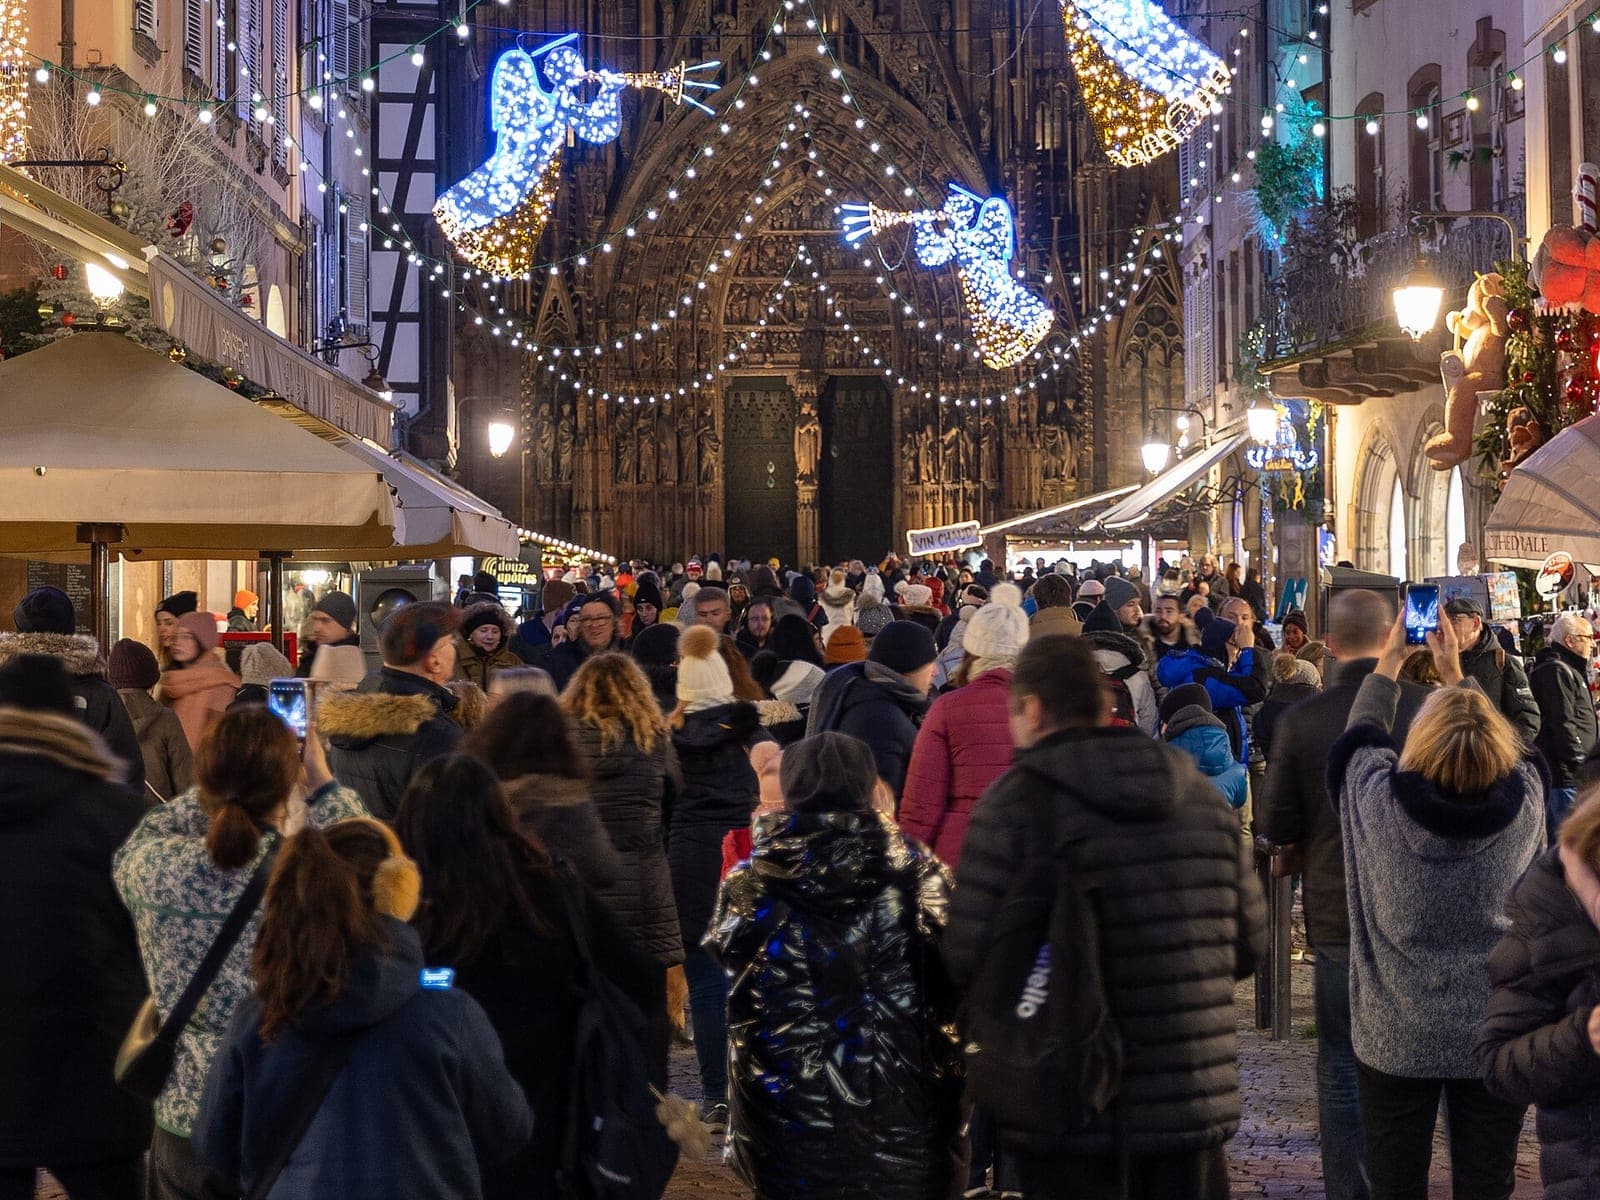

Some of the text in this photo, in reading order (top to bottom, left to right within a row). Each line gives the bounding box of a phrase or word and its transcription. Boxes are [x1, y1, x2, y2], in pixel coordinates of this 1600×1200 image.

[915, 527, 973, 549] VIN CHAUD
[498, 558, 529, 573] douze
[497, 572, 537, 585] apôtres
